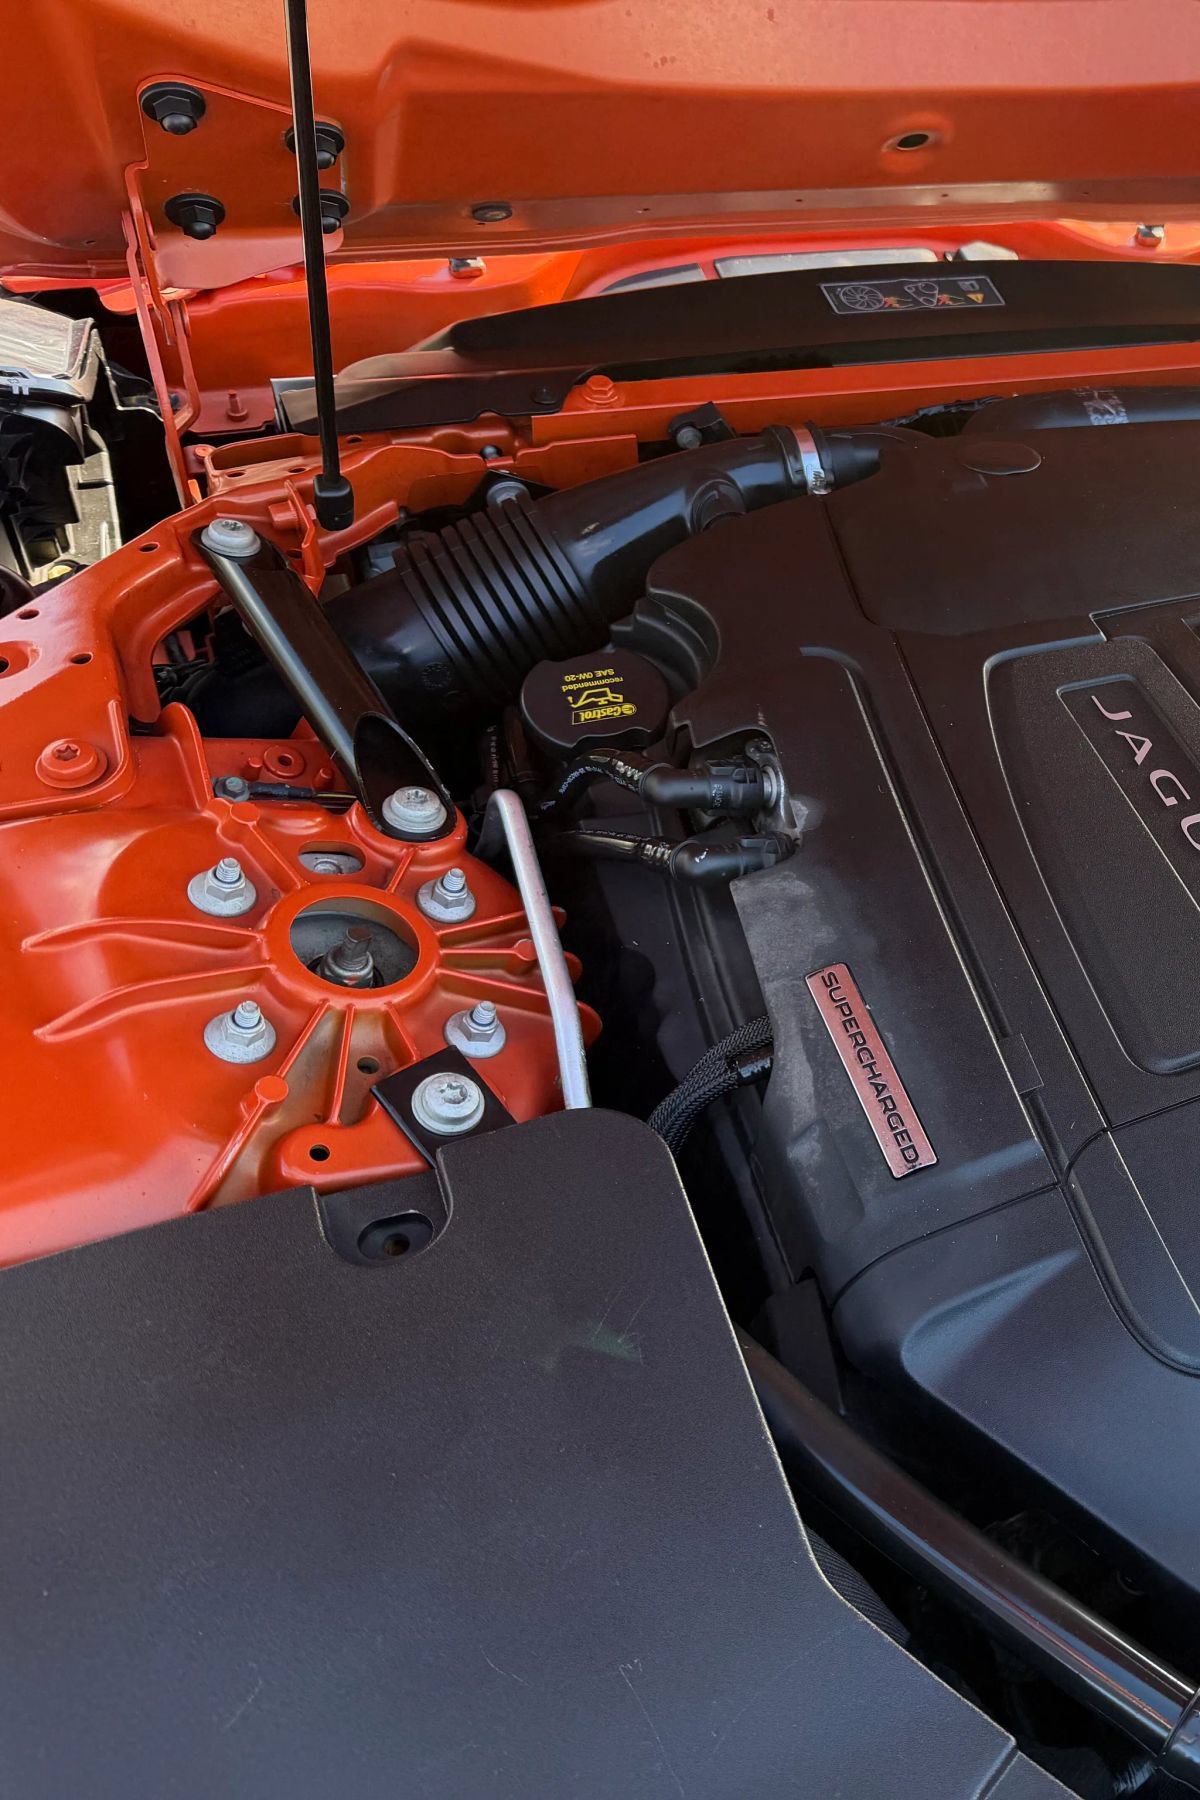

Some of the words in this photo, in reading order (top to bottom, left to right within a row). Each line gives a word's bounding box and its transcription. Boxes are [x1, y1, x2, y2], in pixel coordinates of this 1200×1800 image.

[564, 671, 593, 682] 0W-20
[594, 669, 615, 678] SAE
[562, 677, 624, 692] recommended
[579, 705, 622, 722] Castrol
[821, 970, 921, 1165] SUPERCHARGED
